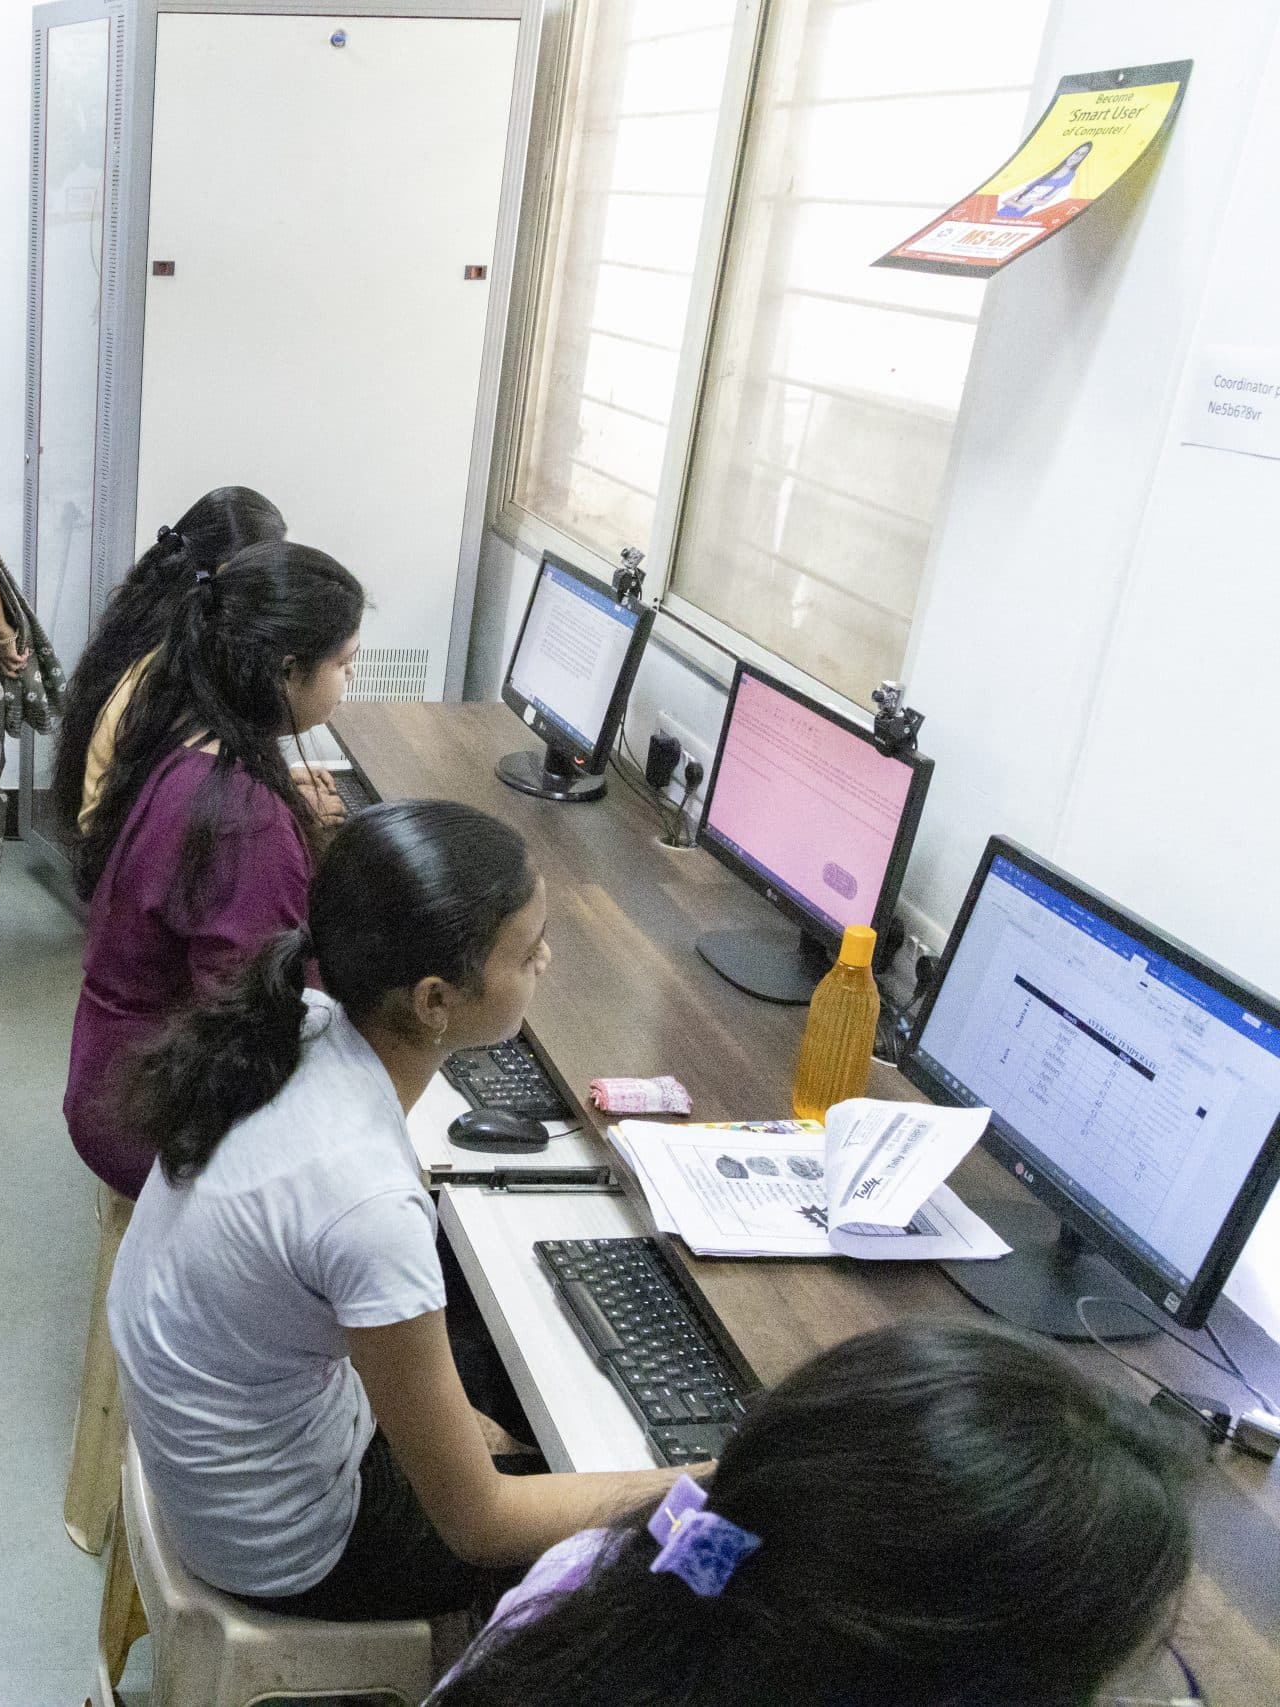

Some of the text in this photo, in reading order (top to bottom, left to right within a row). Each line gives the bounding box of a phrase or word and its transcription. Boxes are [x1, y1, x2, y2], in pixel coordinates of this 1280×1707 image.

[1095, 92, 1135, 105] Become
[956, 228, 1031, 247] MS-CIT
[1214, 374, 1274, 395] Coordinator
[851, 1177, 884, 1201] Tally
